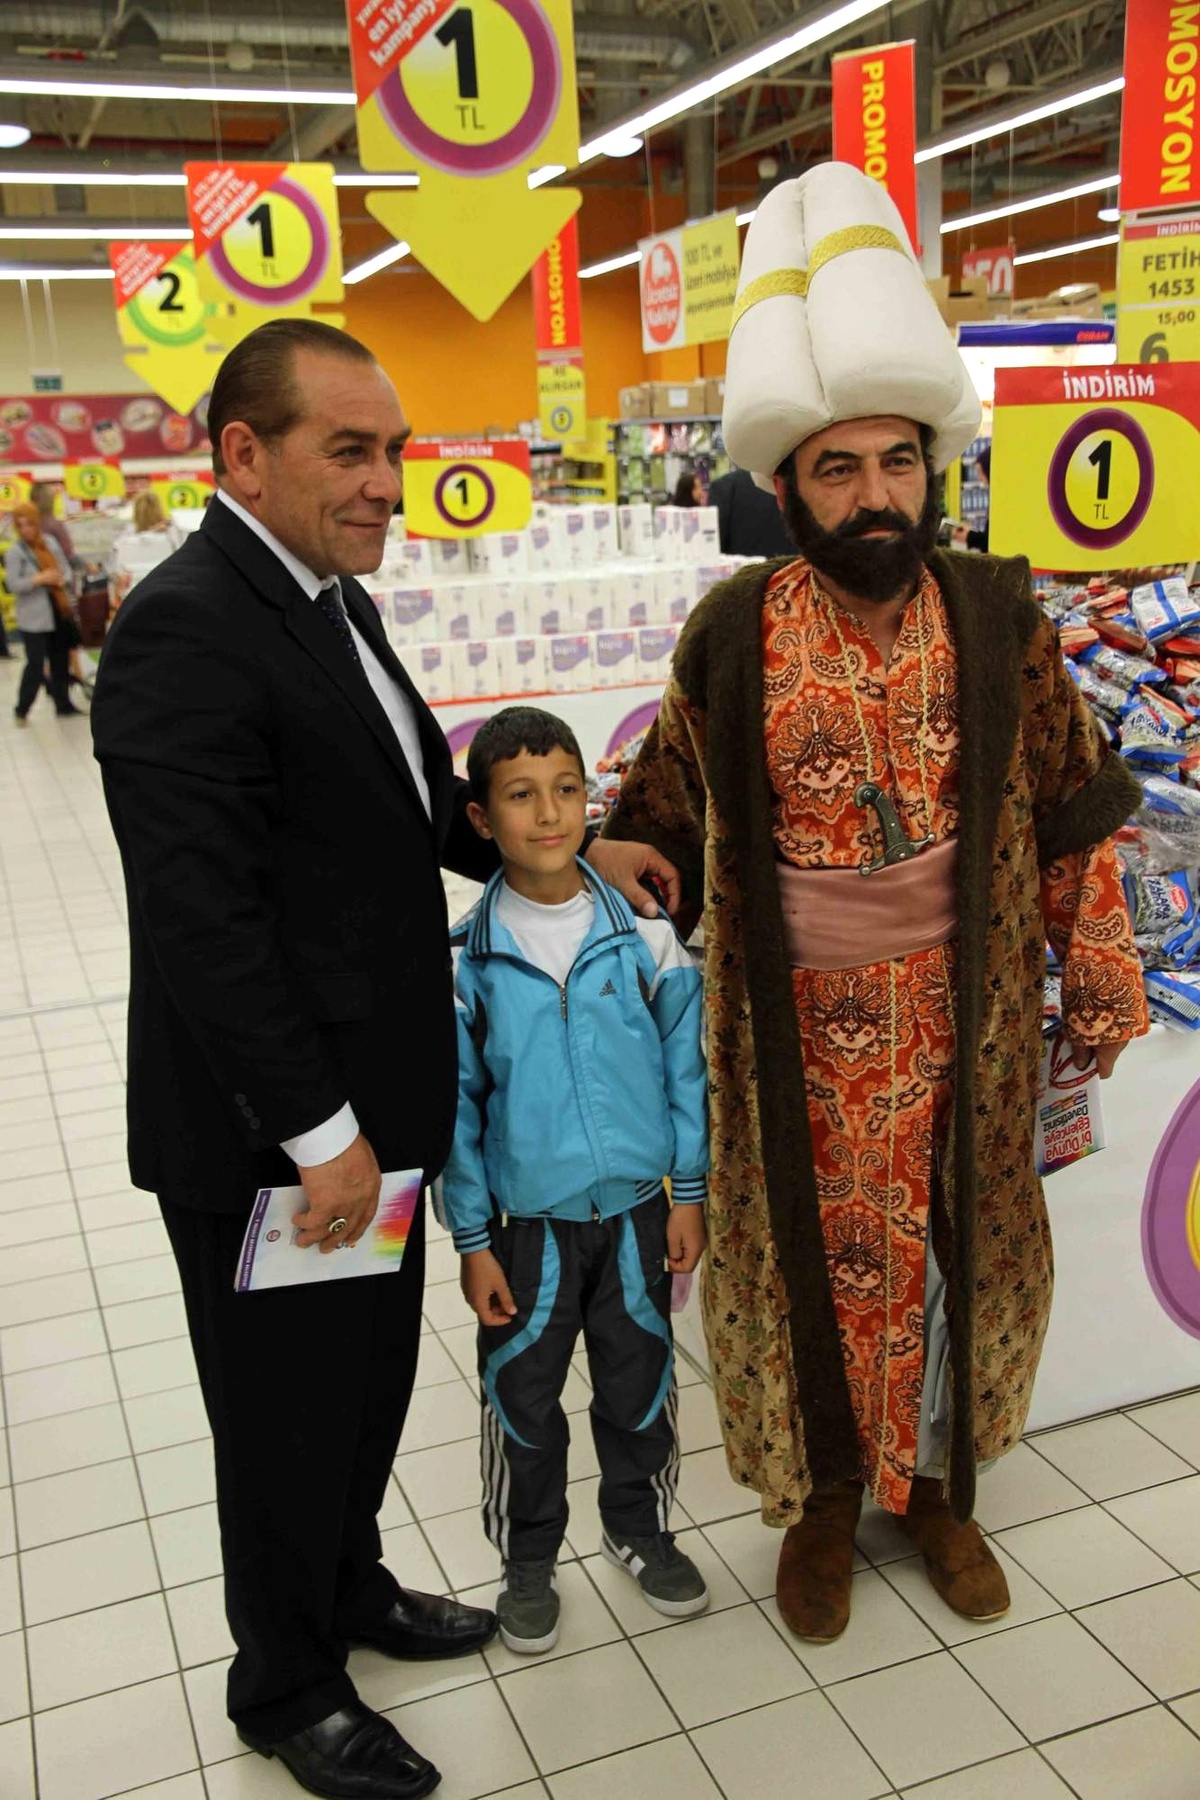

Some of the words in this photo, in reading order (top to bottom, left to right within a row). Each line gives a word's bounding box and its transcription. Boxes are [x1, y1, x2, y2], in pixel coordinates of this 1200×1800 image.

[368, 18, 389, 43] en
[435, 7, 478, 98] 1
[1160, 0, 1200, 194] MOSYON
[456, 105, 485, 130] TL
[861, 59, 889, 191] PROMO
[248, 203, 274, 258] 1
[261, 260, 280, 279] TL
[1142, 246, 1200, 273] FETİH
[157, 272, 184, 311] 2
[1148, 278, 1195, 299] 1453
[1158, 310, 1196, 326] 15,00
[1139, 332, 1170, 364] 6
[1062, 368, 1156, 400] İNDİRİM
[1088, 440, 1112, 500] 1
[455, 478, 468, 505] 1
[1094, 503, 1109, 520] TL
